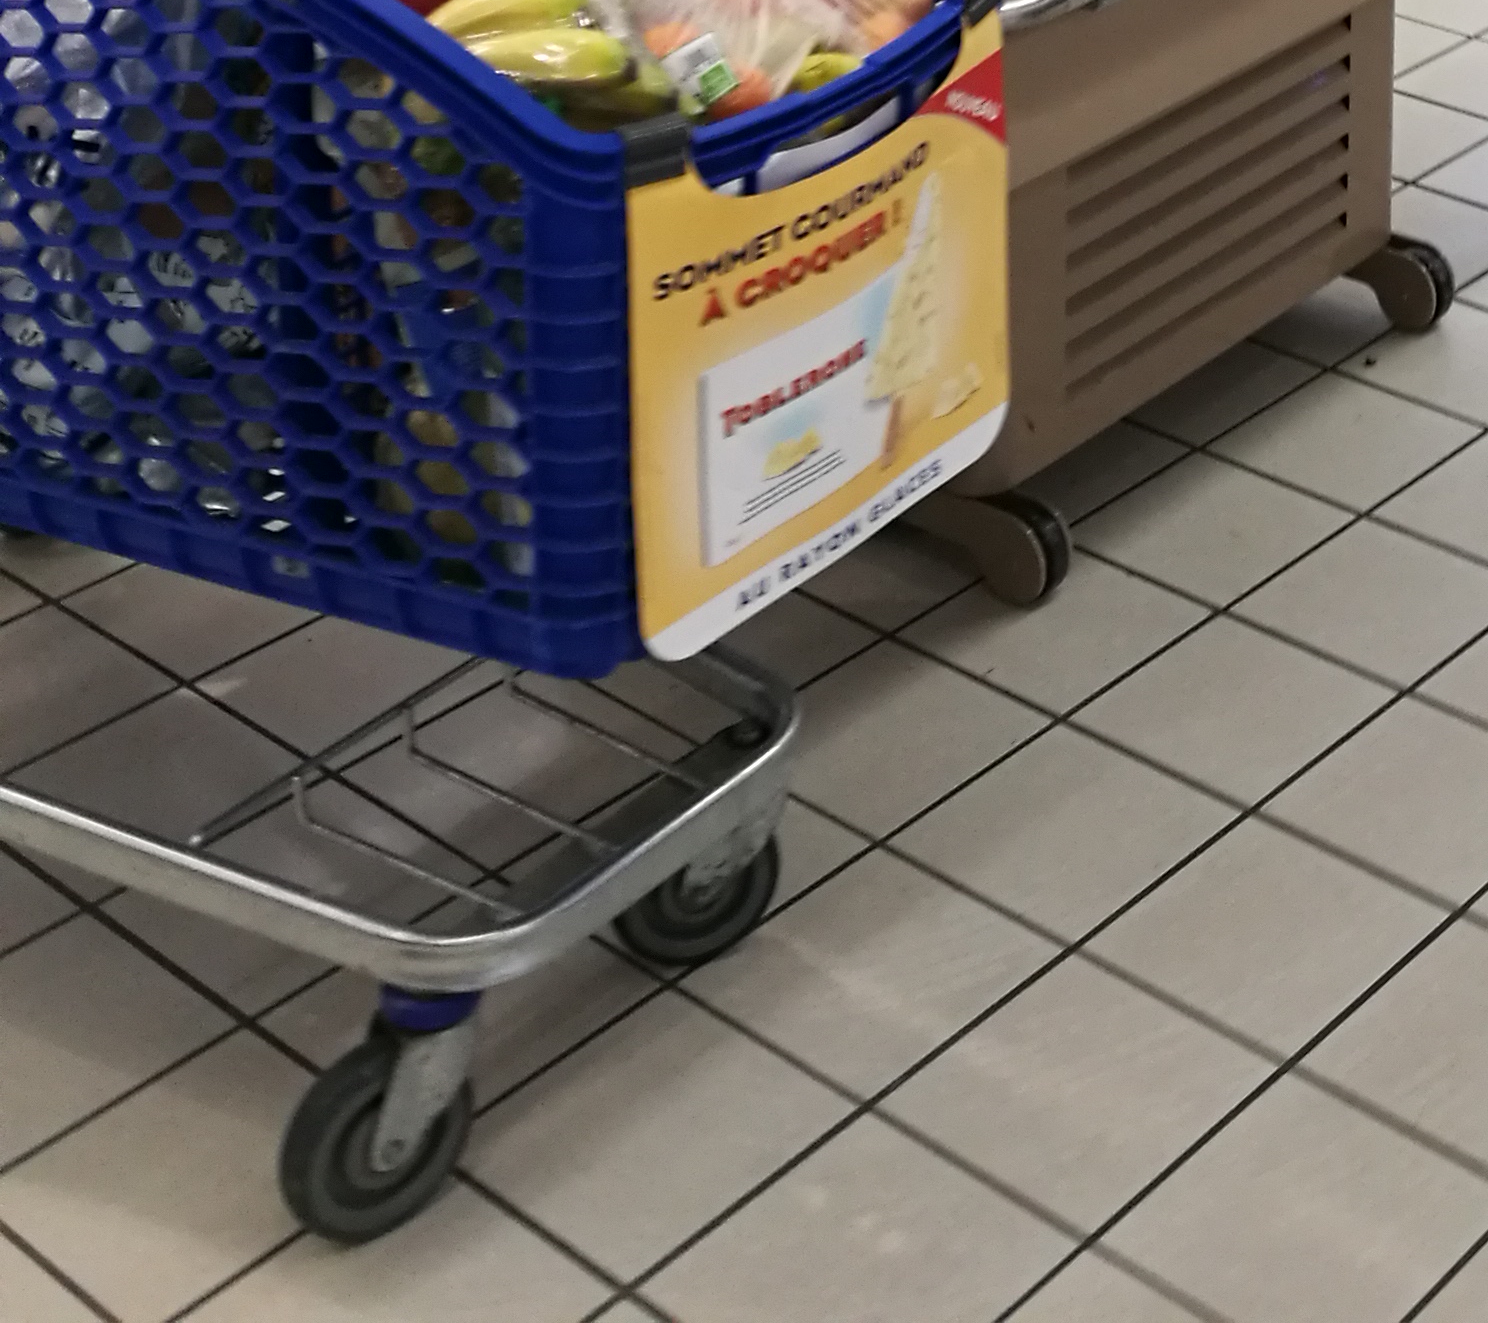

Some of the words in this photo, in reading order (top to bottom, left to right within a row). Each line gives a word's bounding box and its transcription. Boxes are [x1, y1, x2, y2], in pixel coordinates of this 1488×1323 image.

[652, 223, 786, 301] SOMMET
[790, 139, 931, 243] GOURMAND
[733, 209, 888, 310] CROQUER
